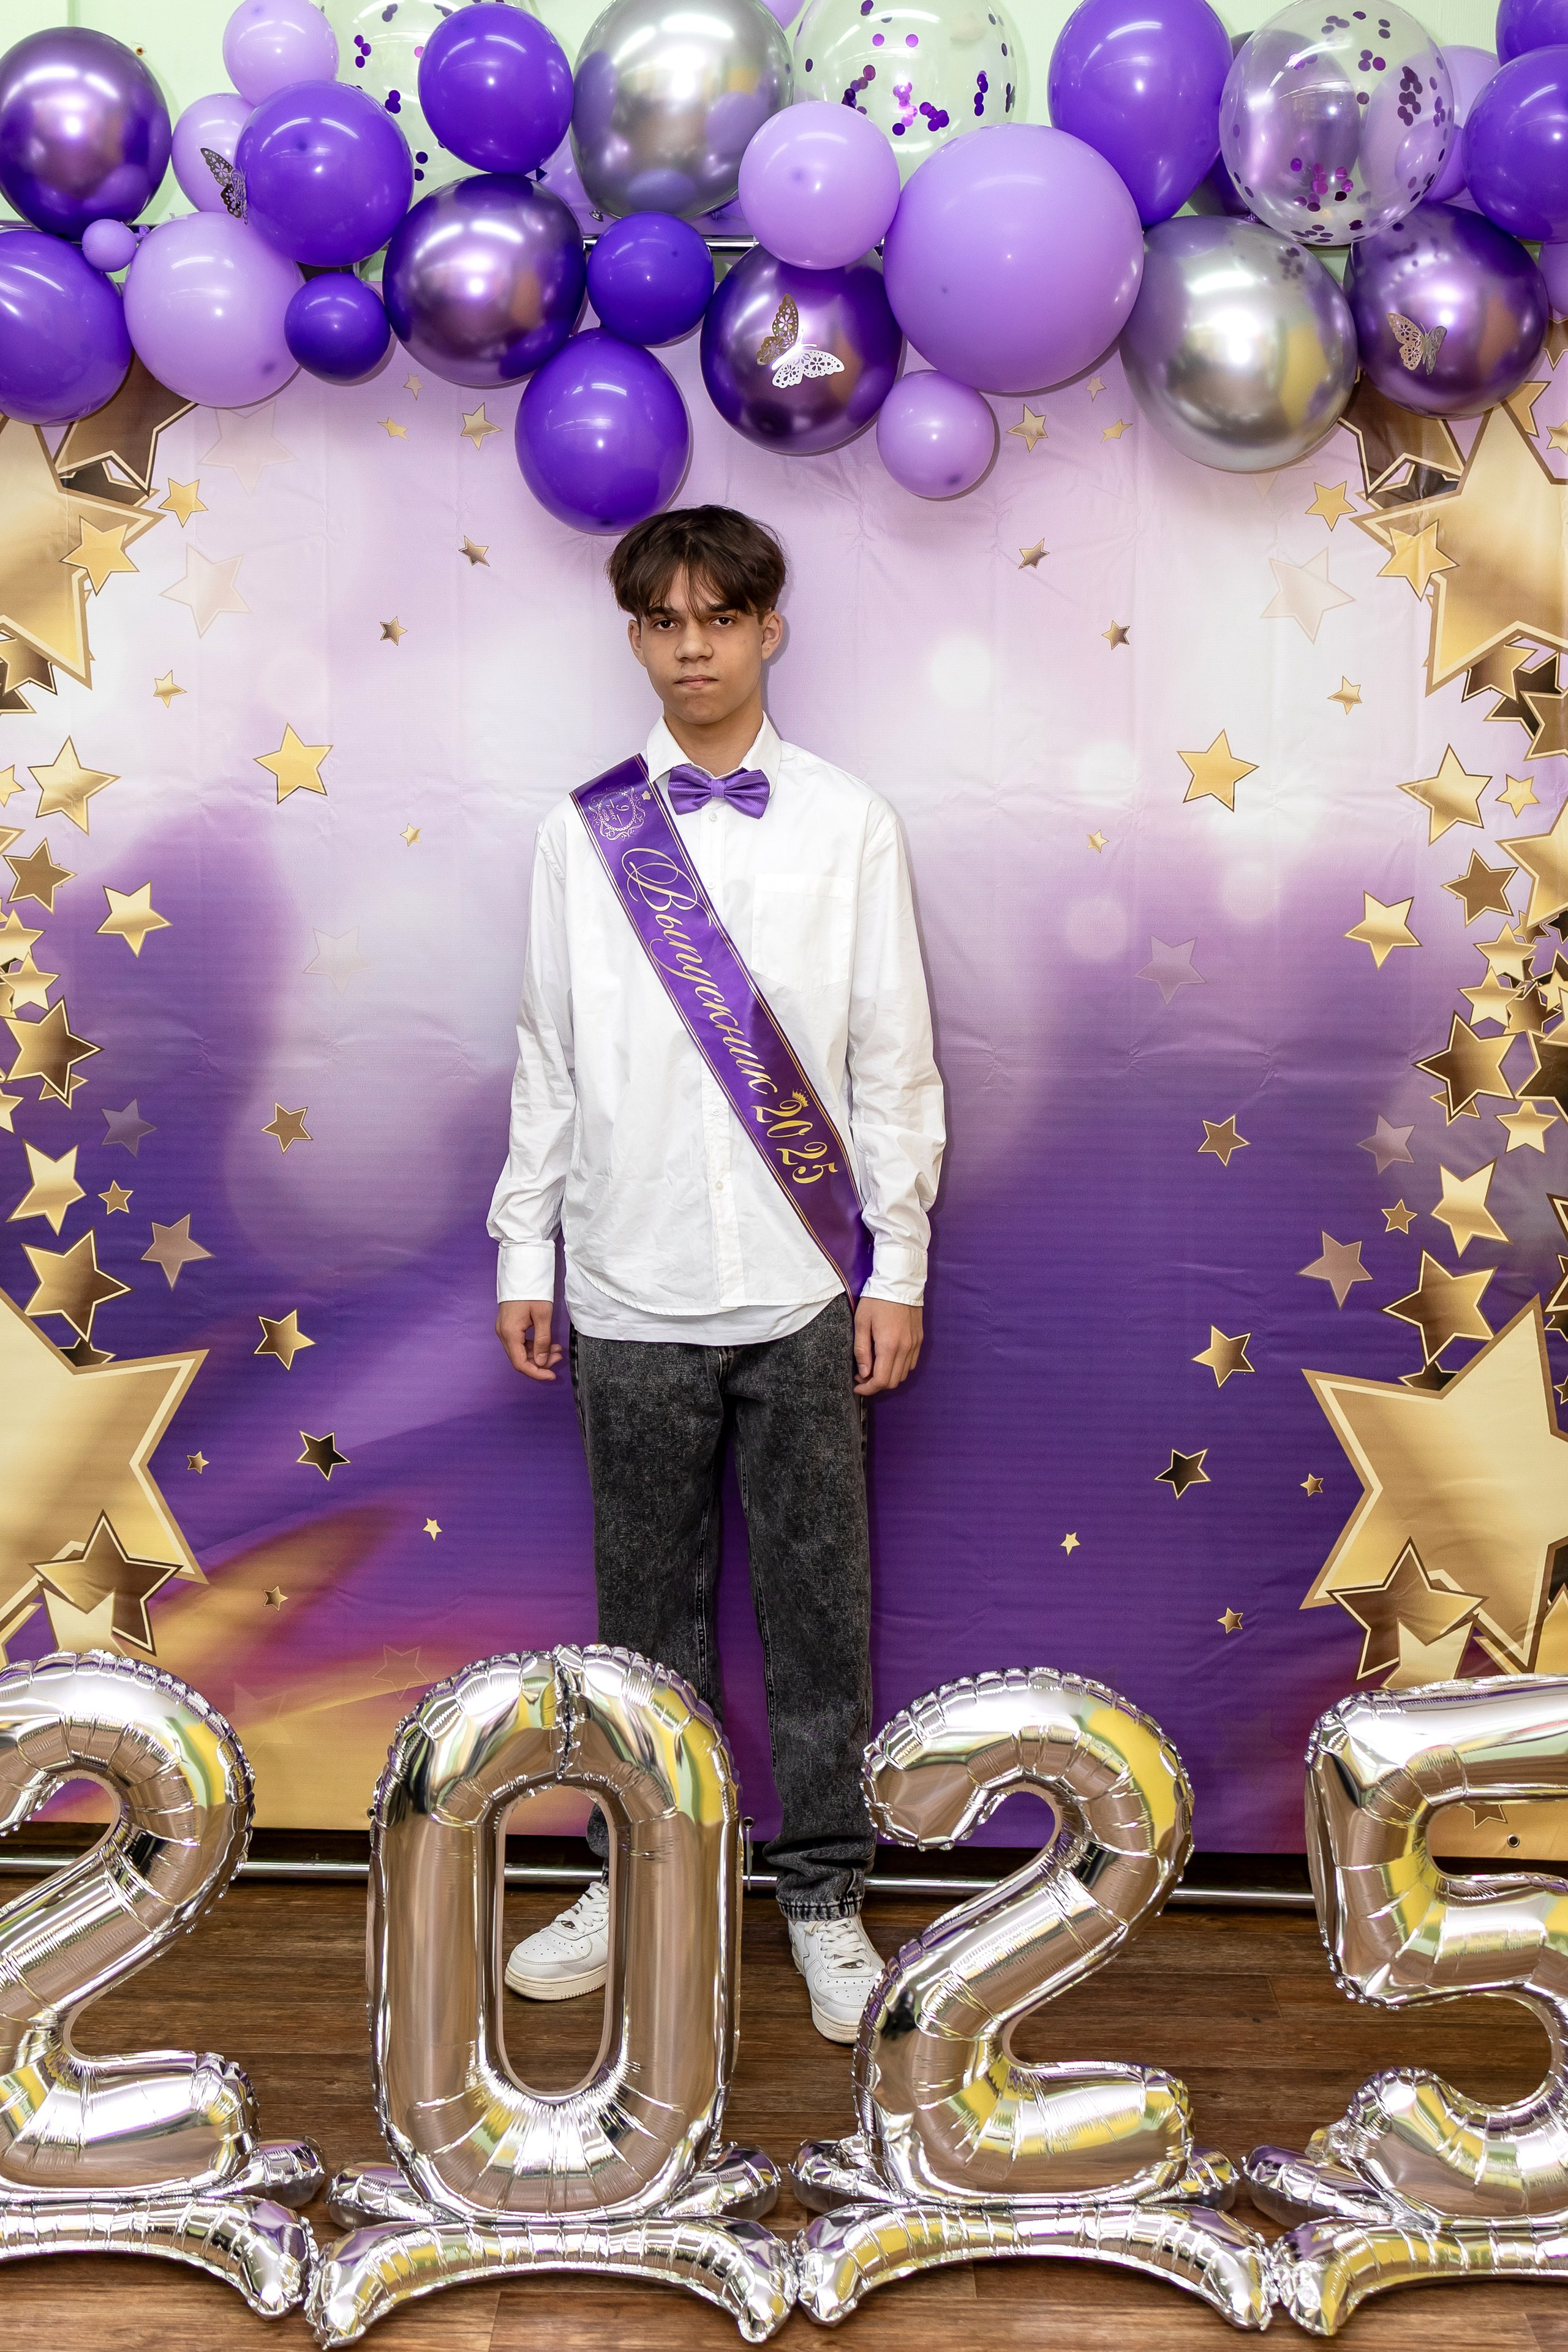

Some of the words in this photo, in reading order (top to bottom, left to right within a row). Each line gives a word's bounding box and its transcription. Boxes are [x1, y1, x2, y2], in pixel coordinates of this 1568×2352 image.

[622, 848, 778, 1095] Выпускник
[750, 1099, 839, 1184] 2025
[0, 1645, 1568, 2225] 2025
